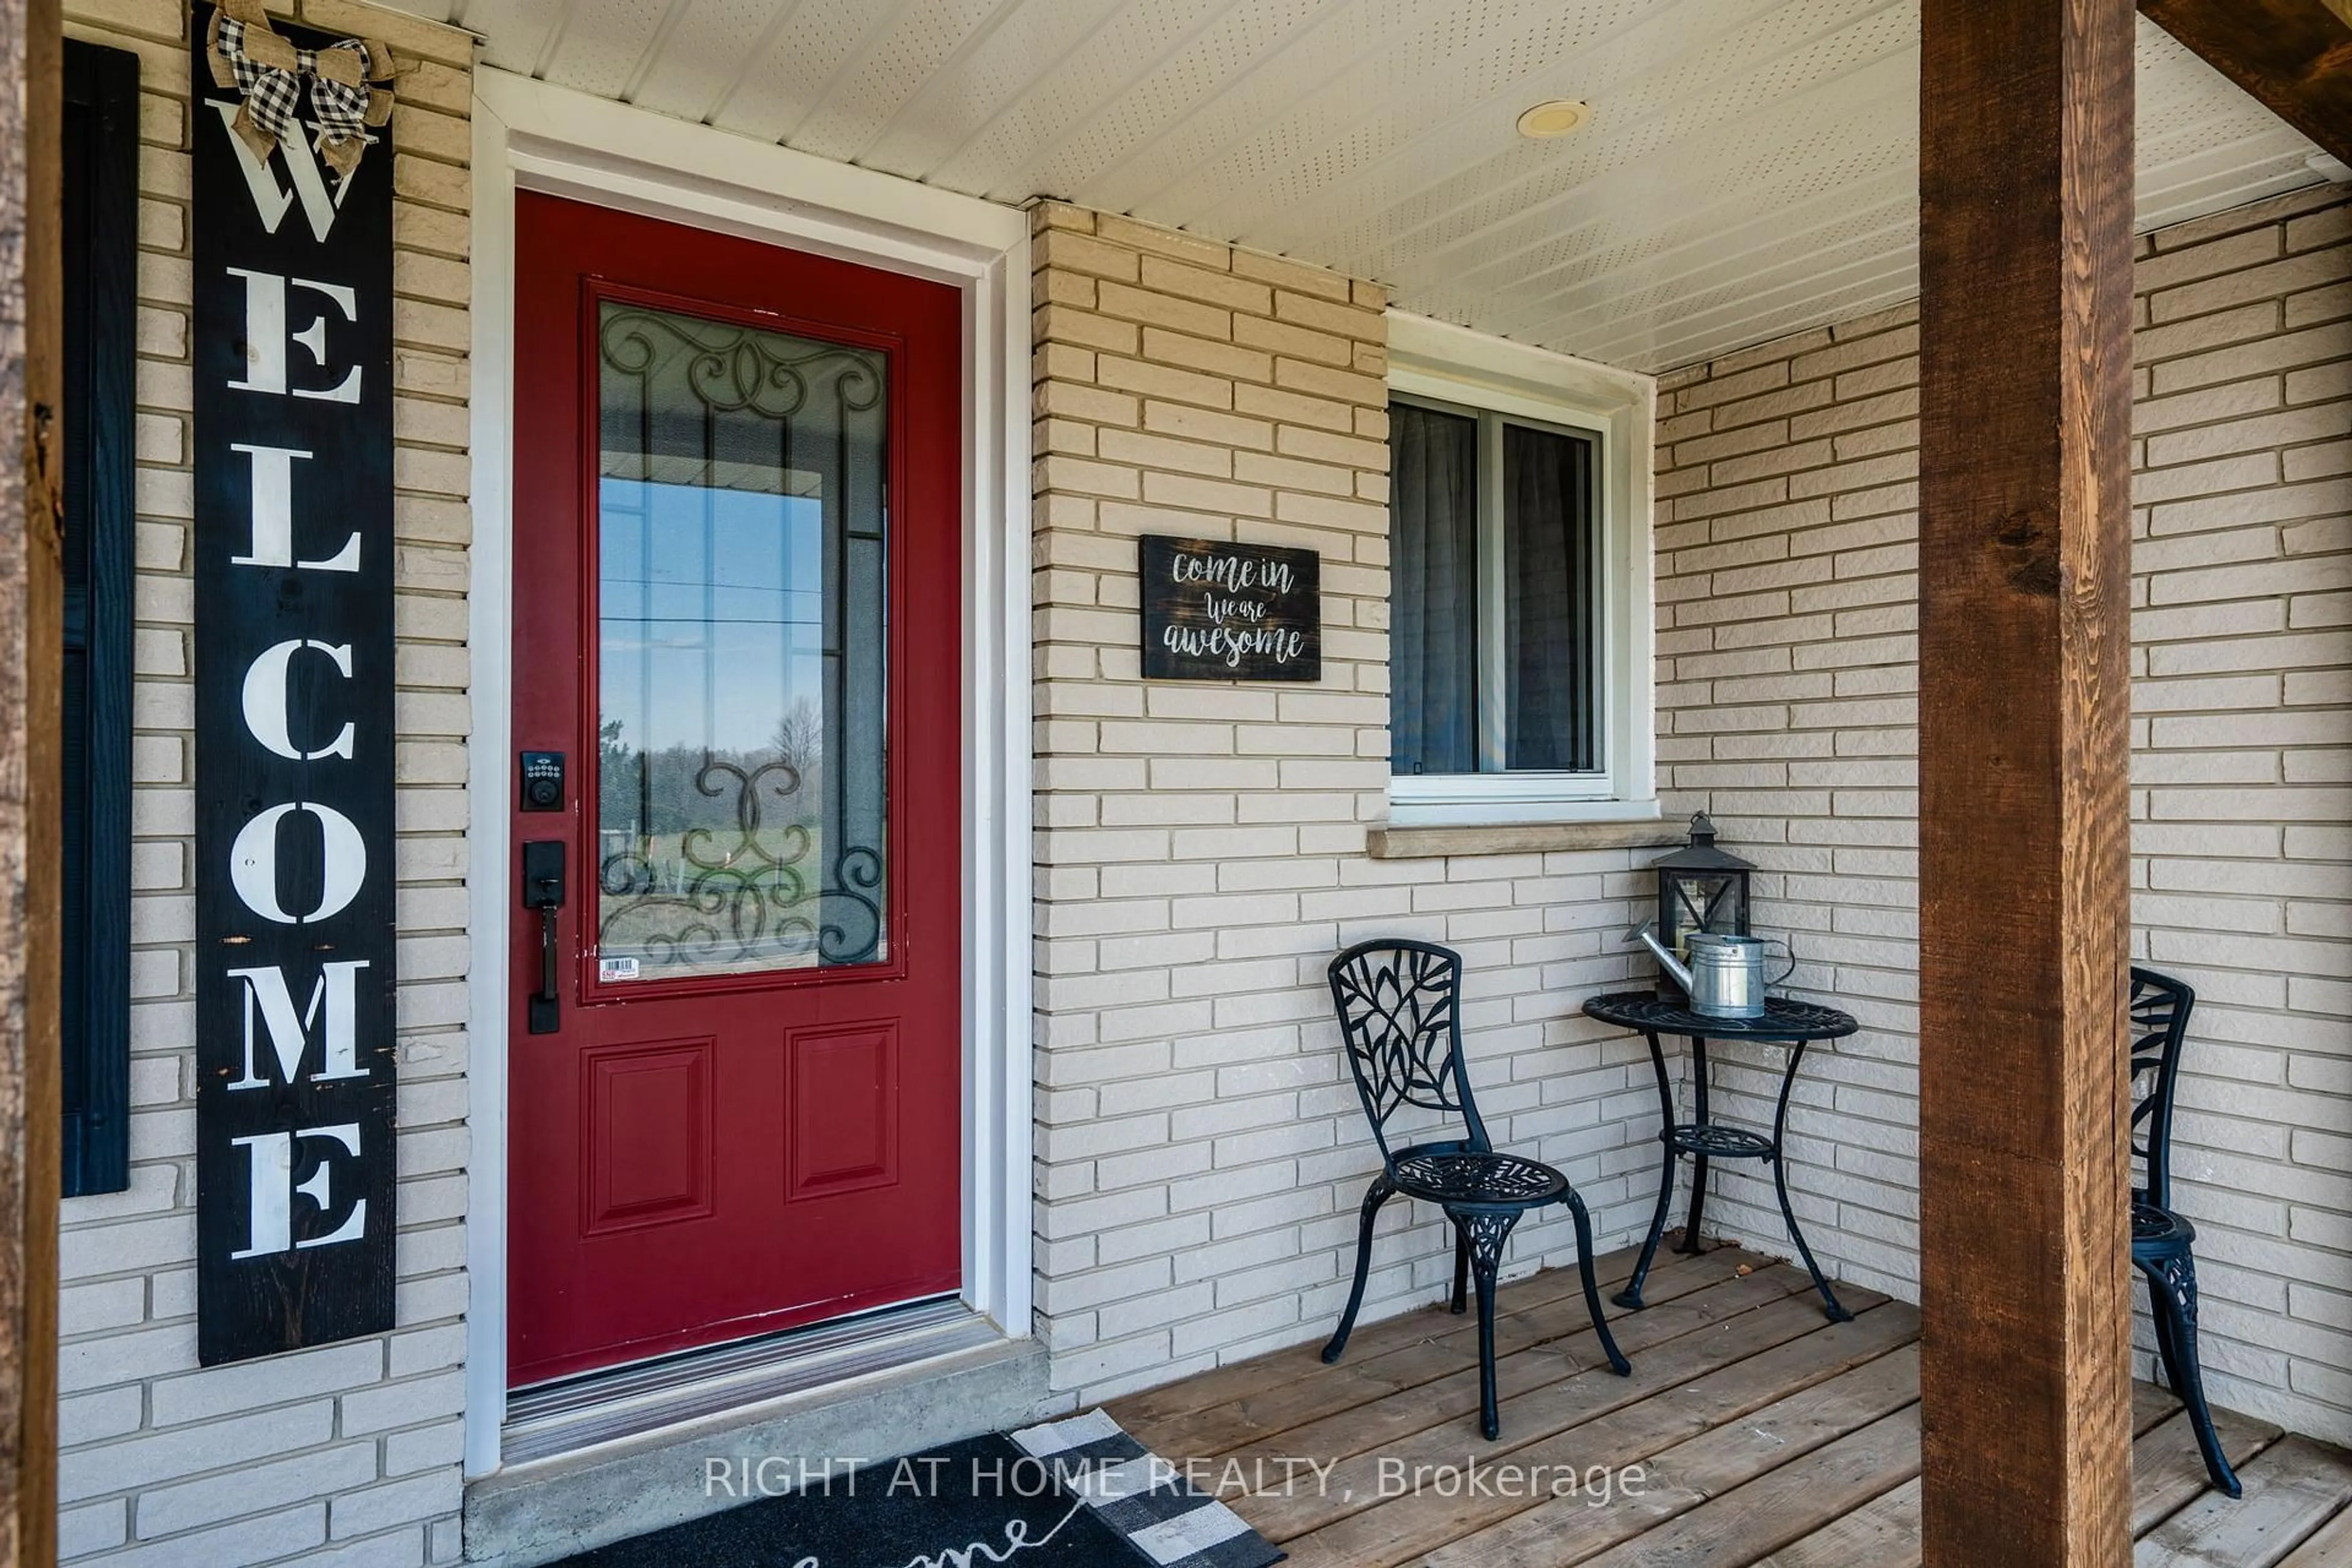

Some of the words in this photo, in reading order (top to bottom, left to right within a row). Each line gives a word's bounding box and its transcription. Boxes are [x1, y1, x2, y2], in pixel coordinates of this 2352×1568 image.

[1261, 558, 1295, 595] in
[1240, 600, 1266, 622] are
[1164, 625, 1304, 668] awesome
[205, 98, 379, 1259] WELCOME
